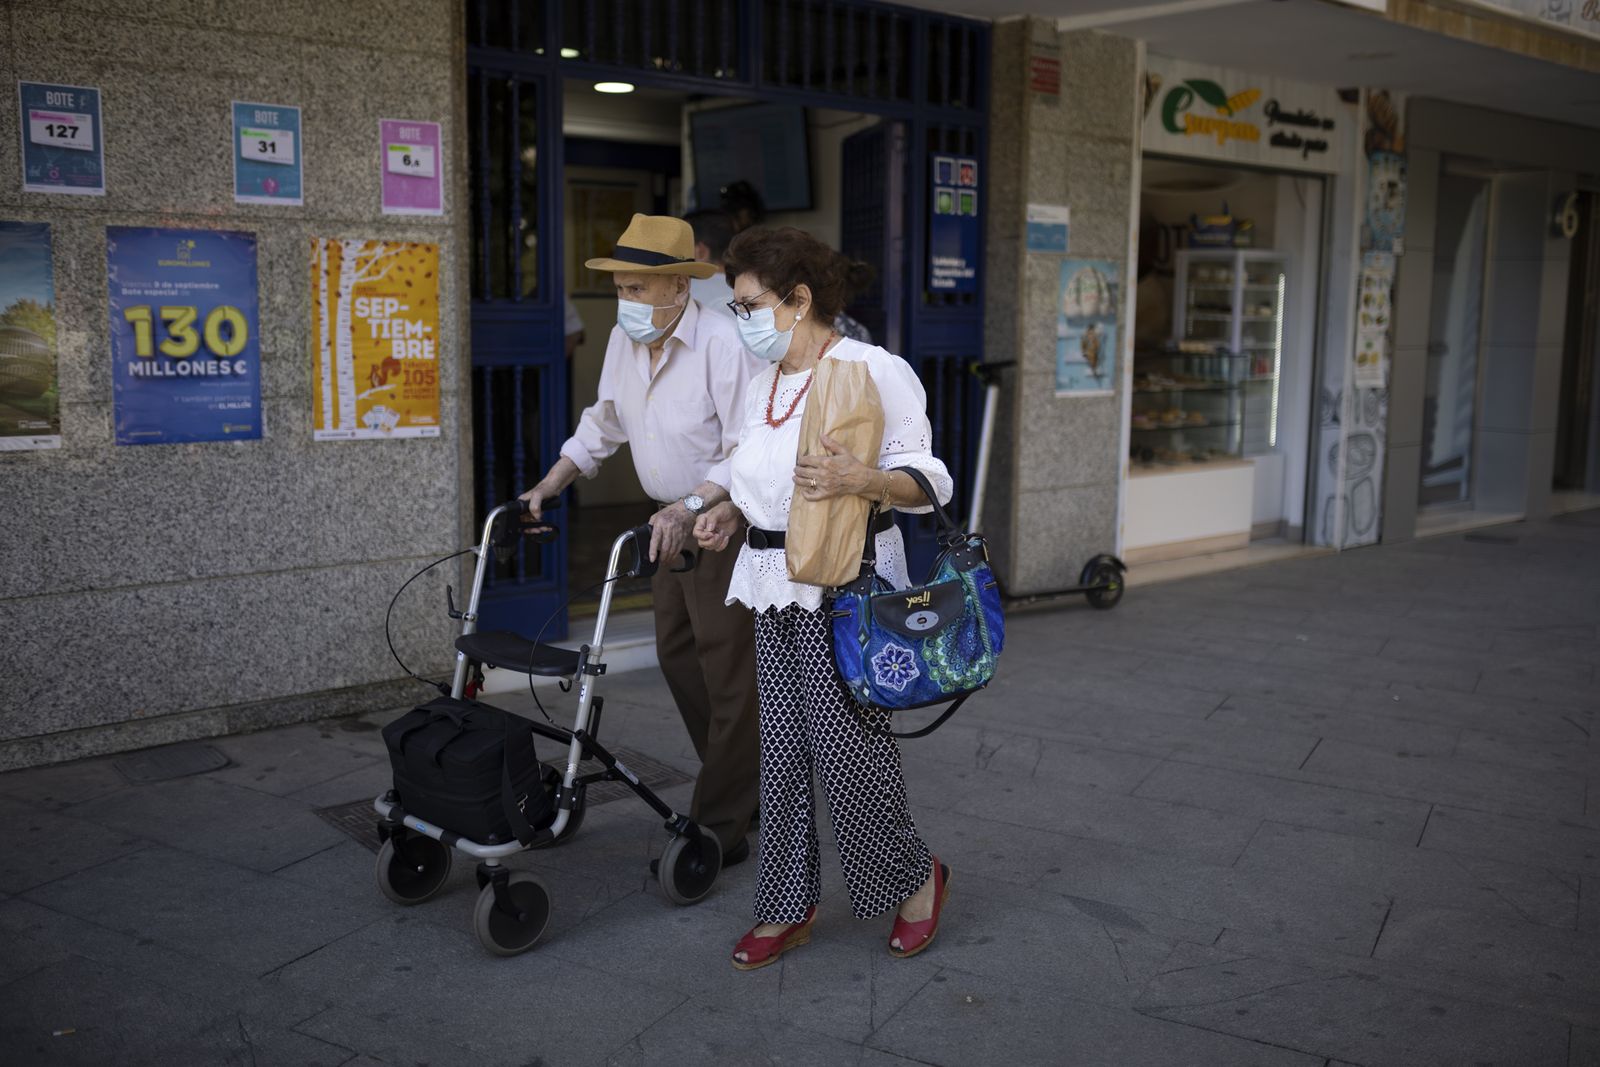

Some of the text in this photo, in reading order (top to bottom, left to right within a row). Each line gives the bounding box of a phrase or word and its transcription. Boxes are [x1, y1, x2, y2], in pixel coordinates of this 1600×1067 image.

[46, 91, 75, 107] BOTE
[254, 110, 280, 125] BOTE
[45, 124, 79, 139] 127
[399, 127, 421, 140] BOTE
[258, 141, 276, 154] 31
[1561, 192, 1579, 239] 6
[121, 287, 142, 296] Bote
[144, 288, 178, 297] especial
[174, 281, 220, 290] septiembre
[355, 297, 410, 318] SEP-
[123, 305, 249, 358] 130
[367, 318, 433, 339] TIEM-
[391, 339, 435, 360] BRE
[403, 369, 436, 386] 105
[905, 591, 931, 609] yes!!
